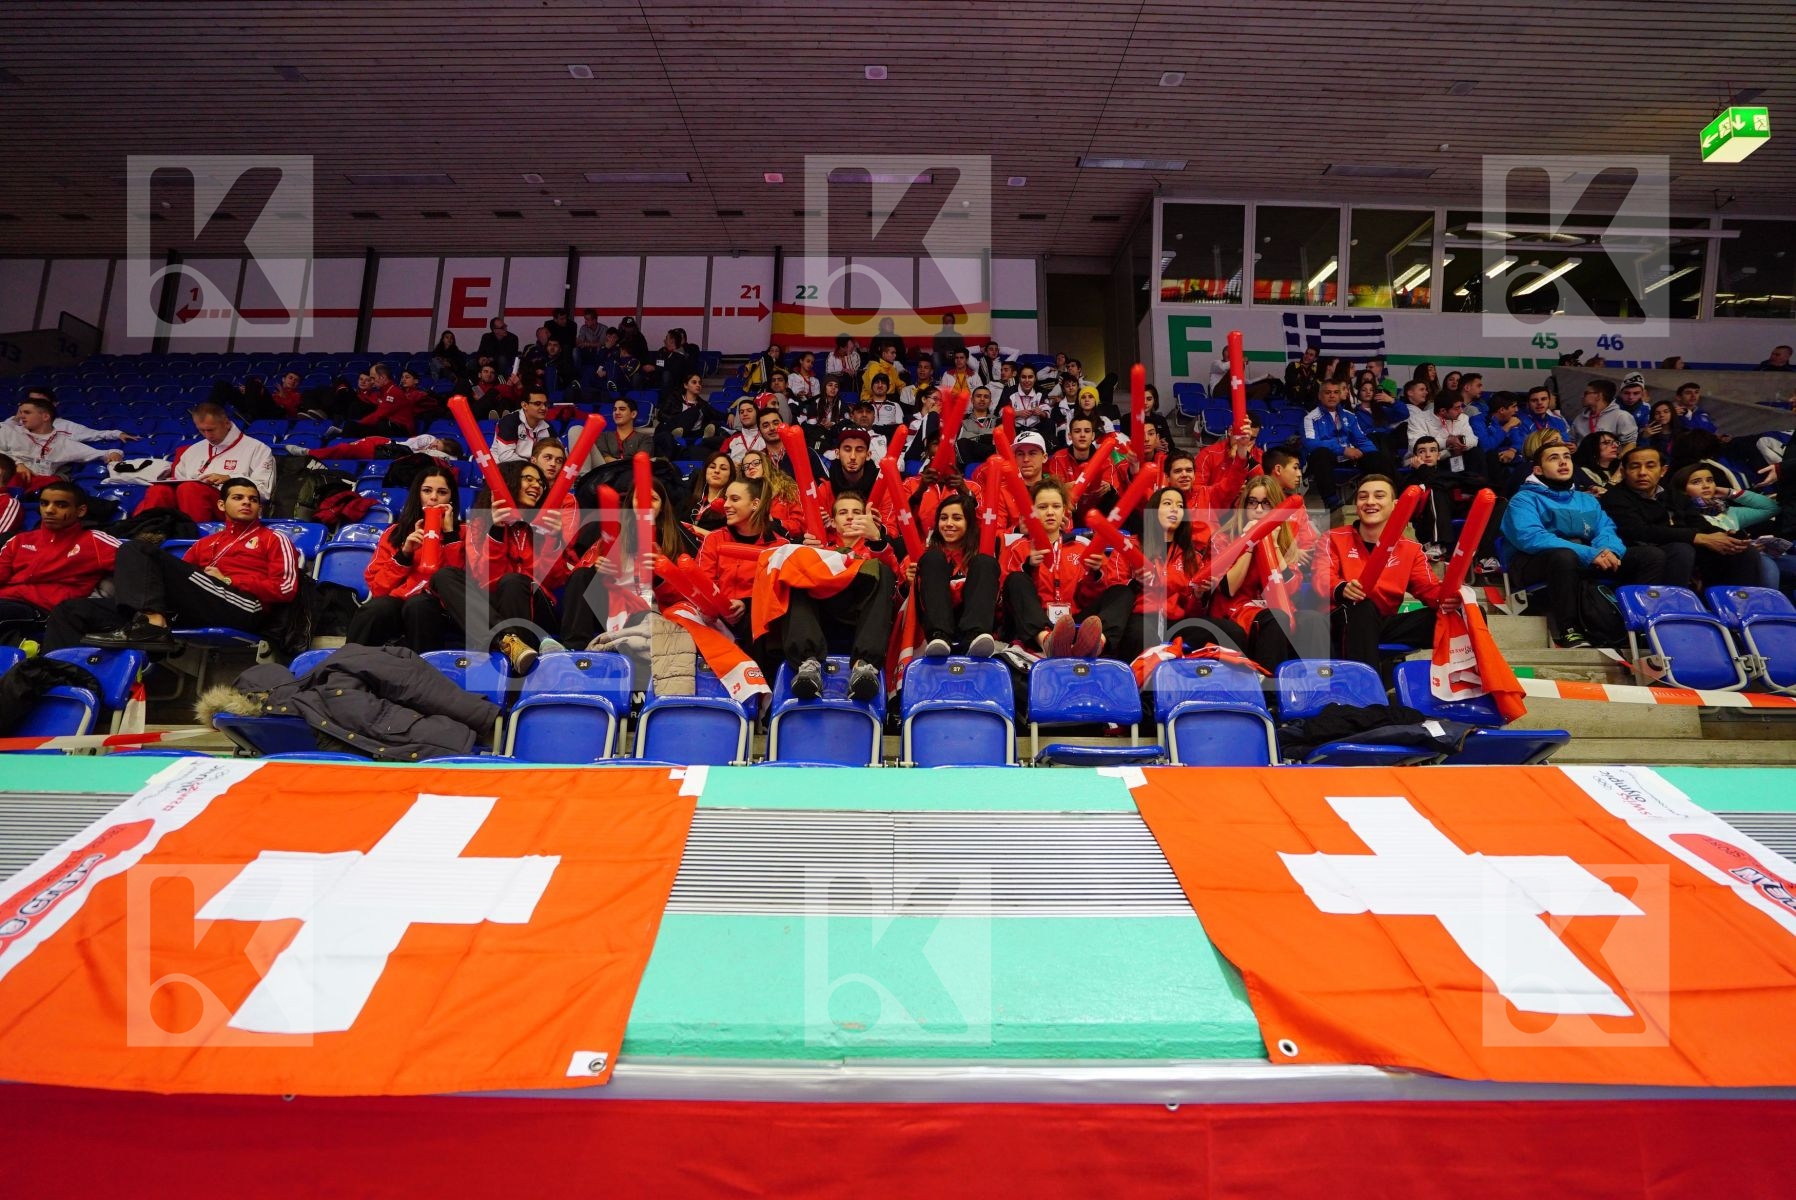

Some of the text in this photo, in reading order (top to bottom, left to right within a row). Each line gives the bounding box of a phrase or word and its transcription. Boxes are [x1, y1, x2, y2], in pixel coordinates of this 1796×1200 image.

[190, 287, 199, 301] 1
[741, 285, 760, 299] 21
[796, 285, 818, 299] 22
[448, 277, 491, 328] E
[1168, 315, 1212, 376] F
[1531, 332, 1559, 349] 45
[1596, 334, 1624, 350] 46
[1599, 769, 1646, 802] olympic
